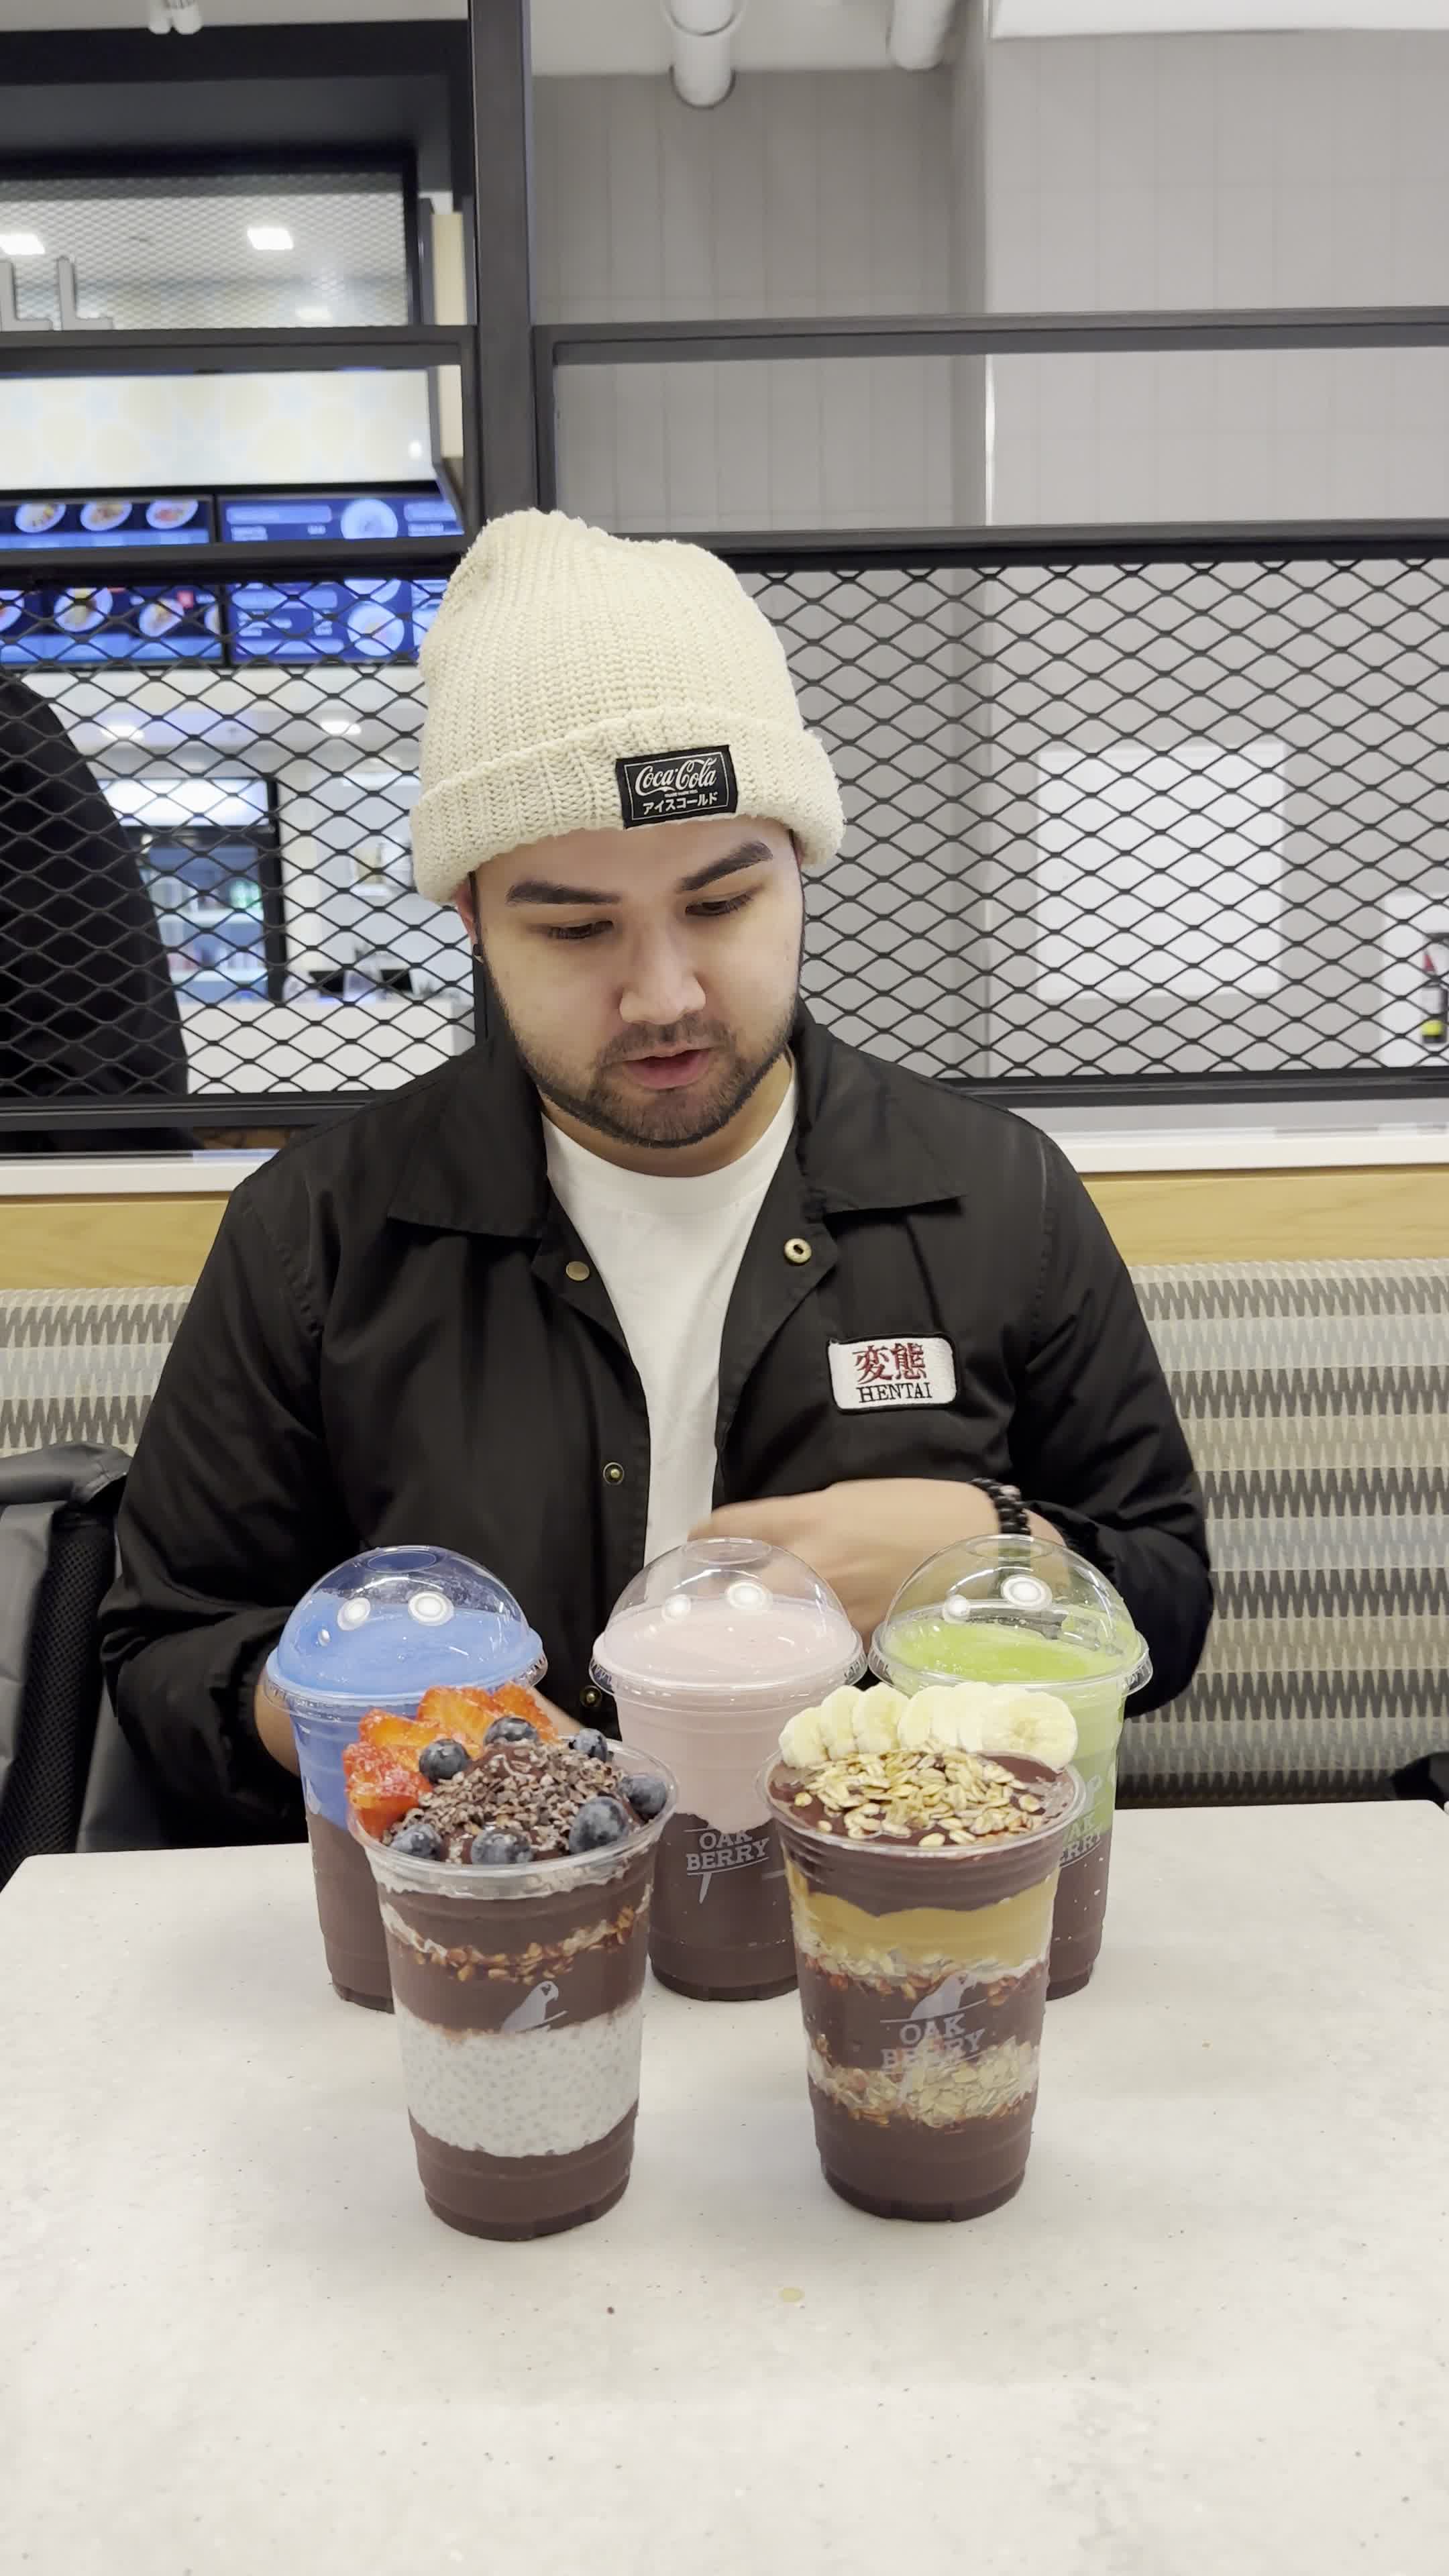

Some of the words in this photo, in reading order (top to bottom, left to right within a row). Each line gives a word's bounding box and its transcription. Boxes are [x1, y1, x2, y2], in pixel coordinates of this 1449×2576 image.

[635, 757, 717, 796] Coca-Cola
[643, 792, 718, 815] アイスコールド
[852, 1342, 927, 1385] 変態
[856, 1382, 932, 1403] HENTAI
[686, 1837, 769, 1870] BERRY
[900, 2013, 965, 2045] OAK
[880, 2028, 985, 2072] BERY
